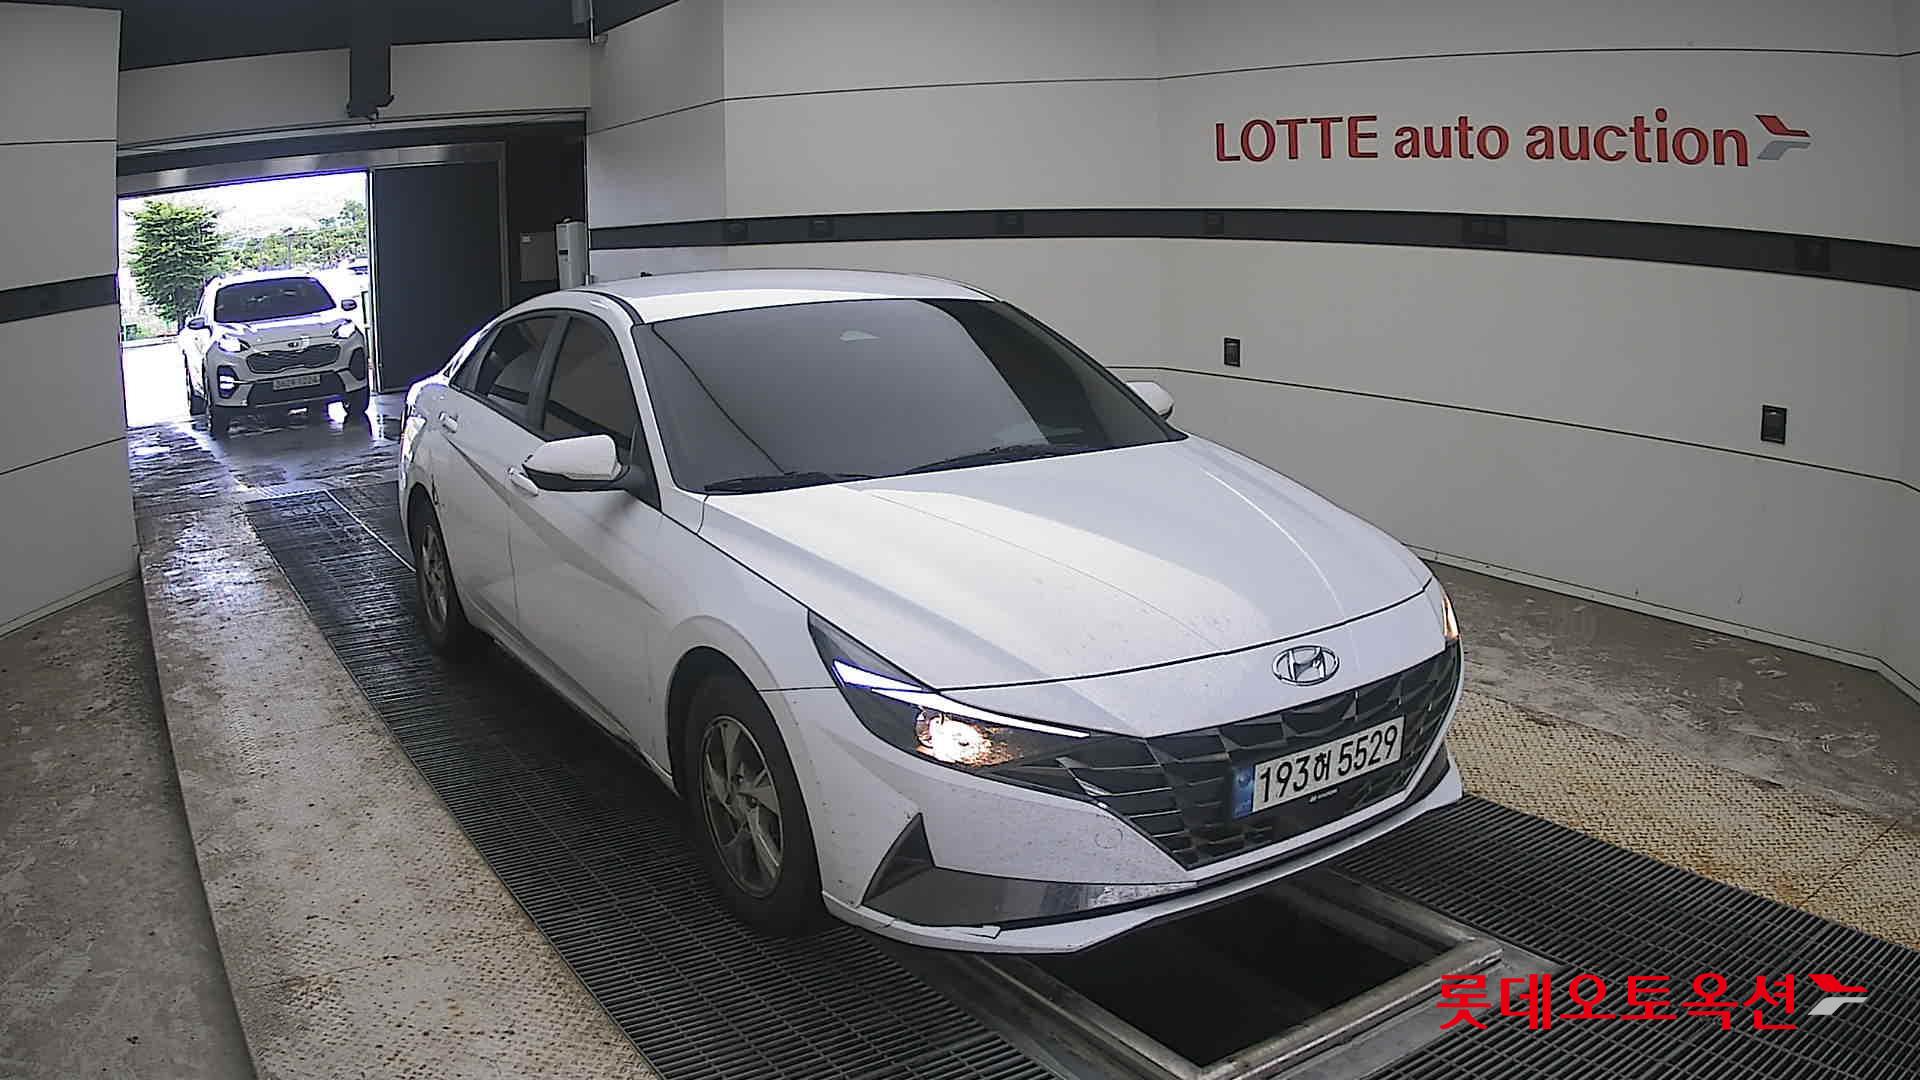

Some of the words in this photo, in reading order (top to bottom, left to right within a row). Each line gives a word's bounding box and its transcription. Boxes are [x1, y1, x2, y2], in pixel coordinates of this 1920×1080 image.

[1215, 115, 1378, 162] LOTTE
[1393, 116, 1510, 160] auto
[1525, 107, 1749, 167] auction
[1259, 750, 1331, 803] 193허
[1338, 725, 1398, 777] 5529
